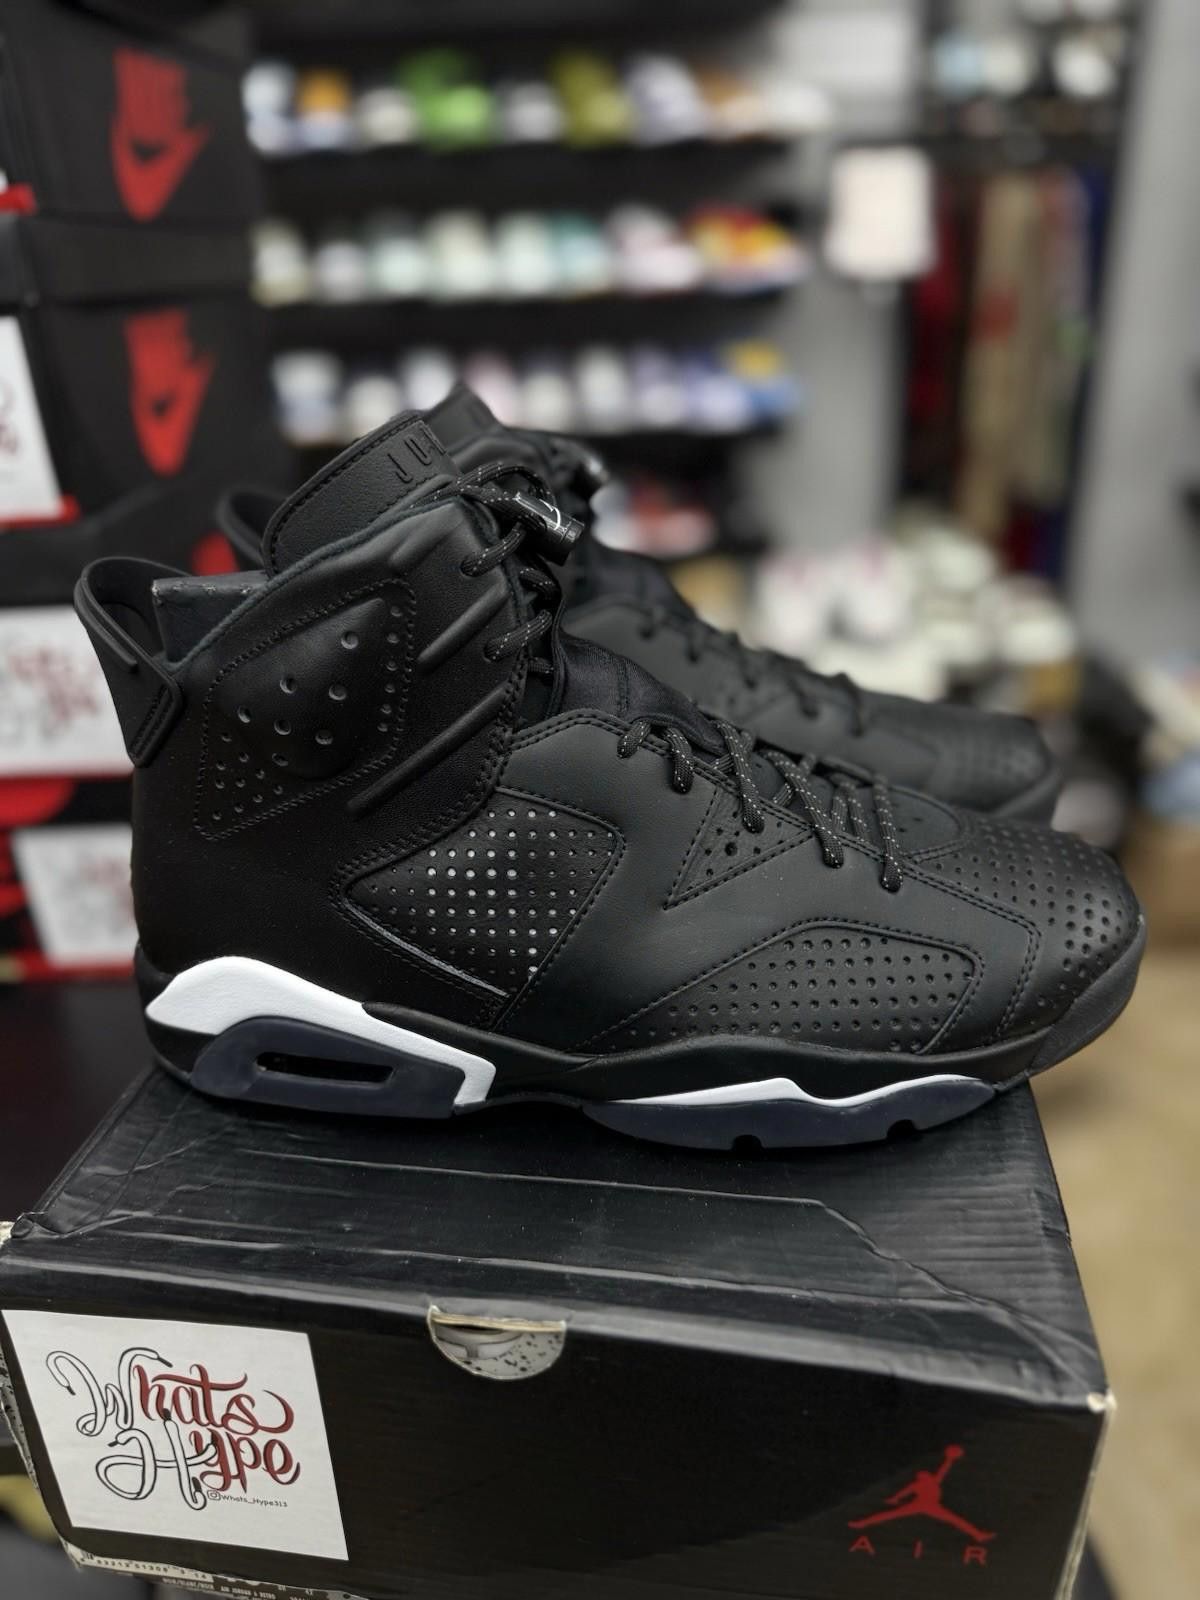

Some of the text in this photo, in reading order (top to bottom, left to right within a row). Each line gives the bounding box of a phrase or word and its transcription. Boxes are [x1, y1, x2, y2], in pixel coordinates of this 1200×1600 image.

[46, 1347, 295, 1437] Whats
[96, 1408, 301, 1511] Hype
[849, 1535, 987, 1566] AIR
